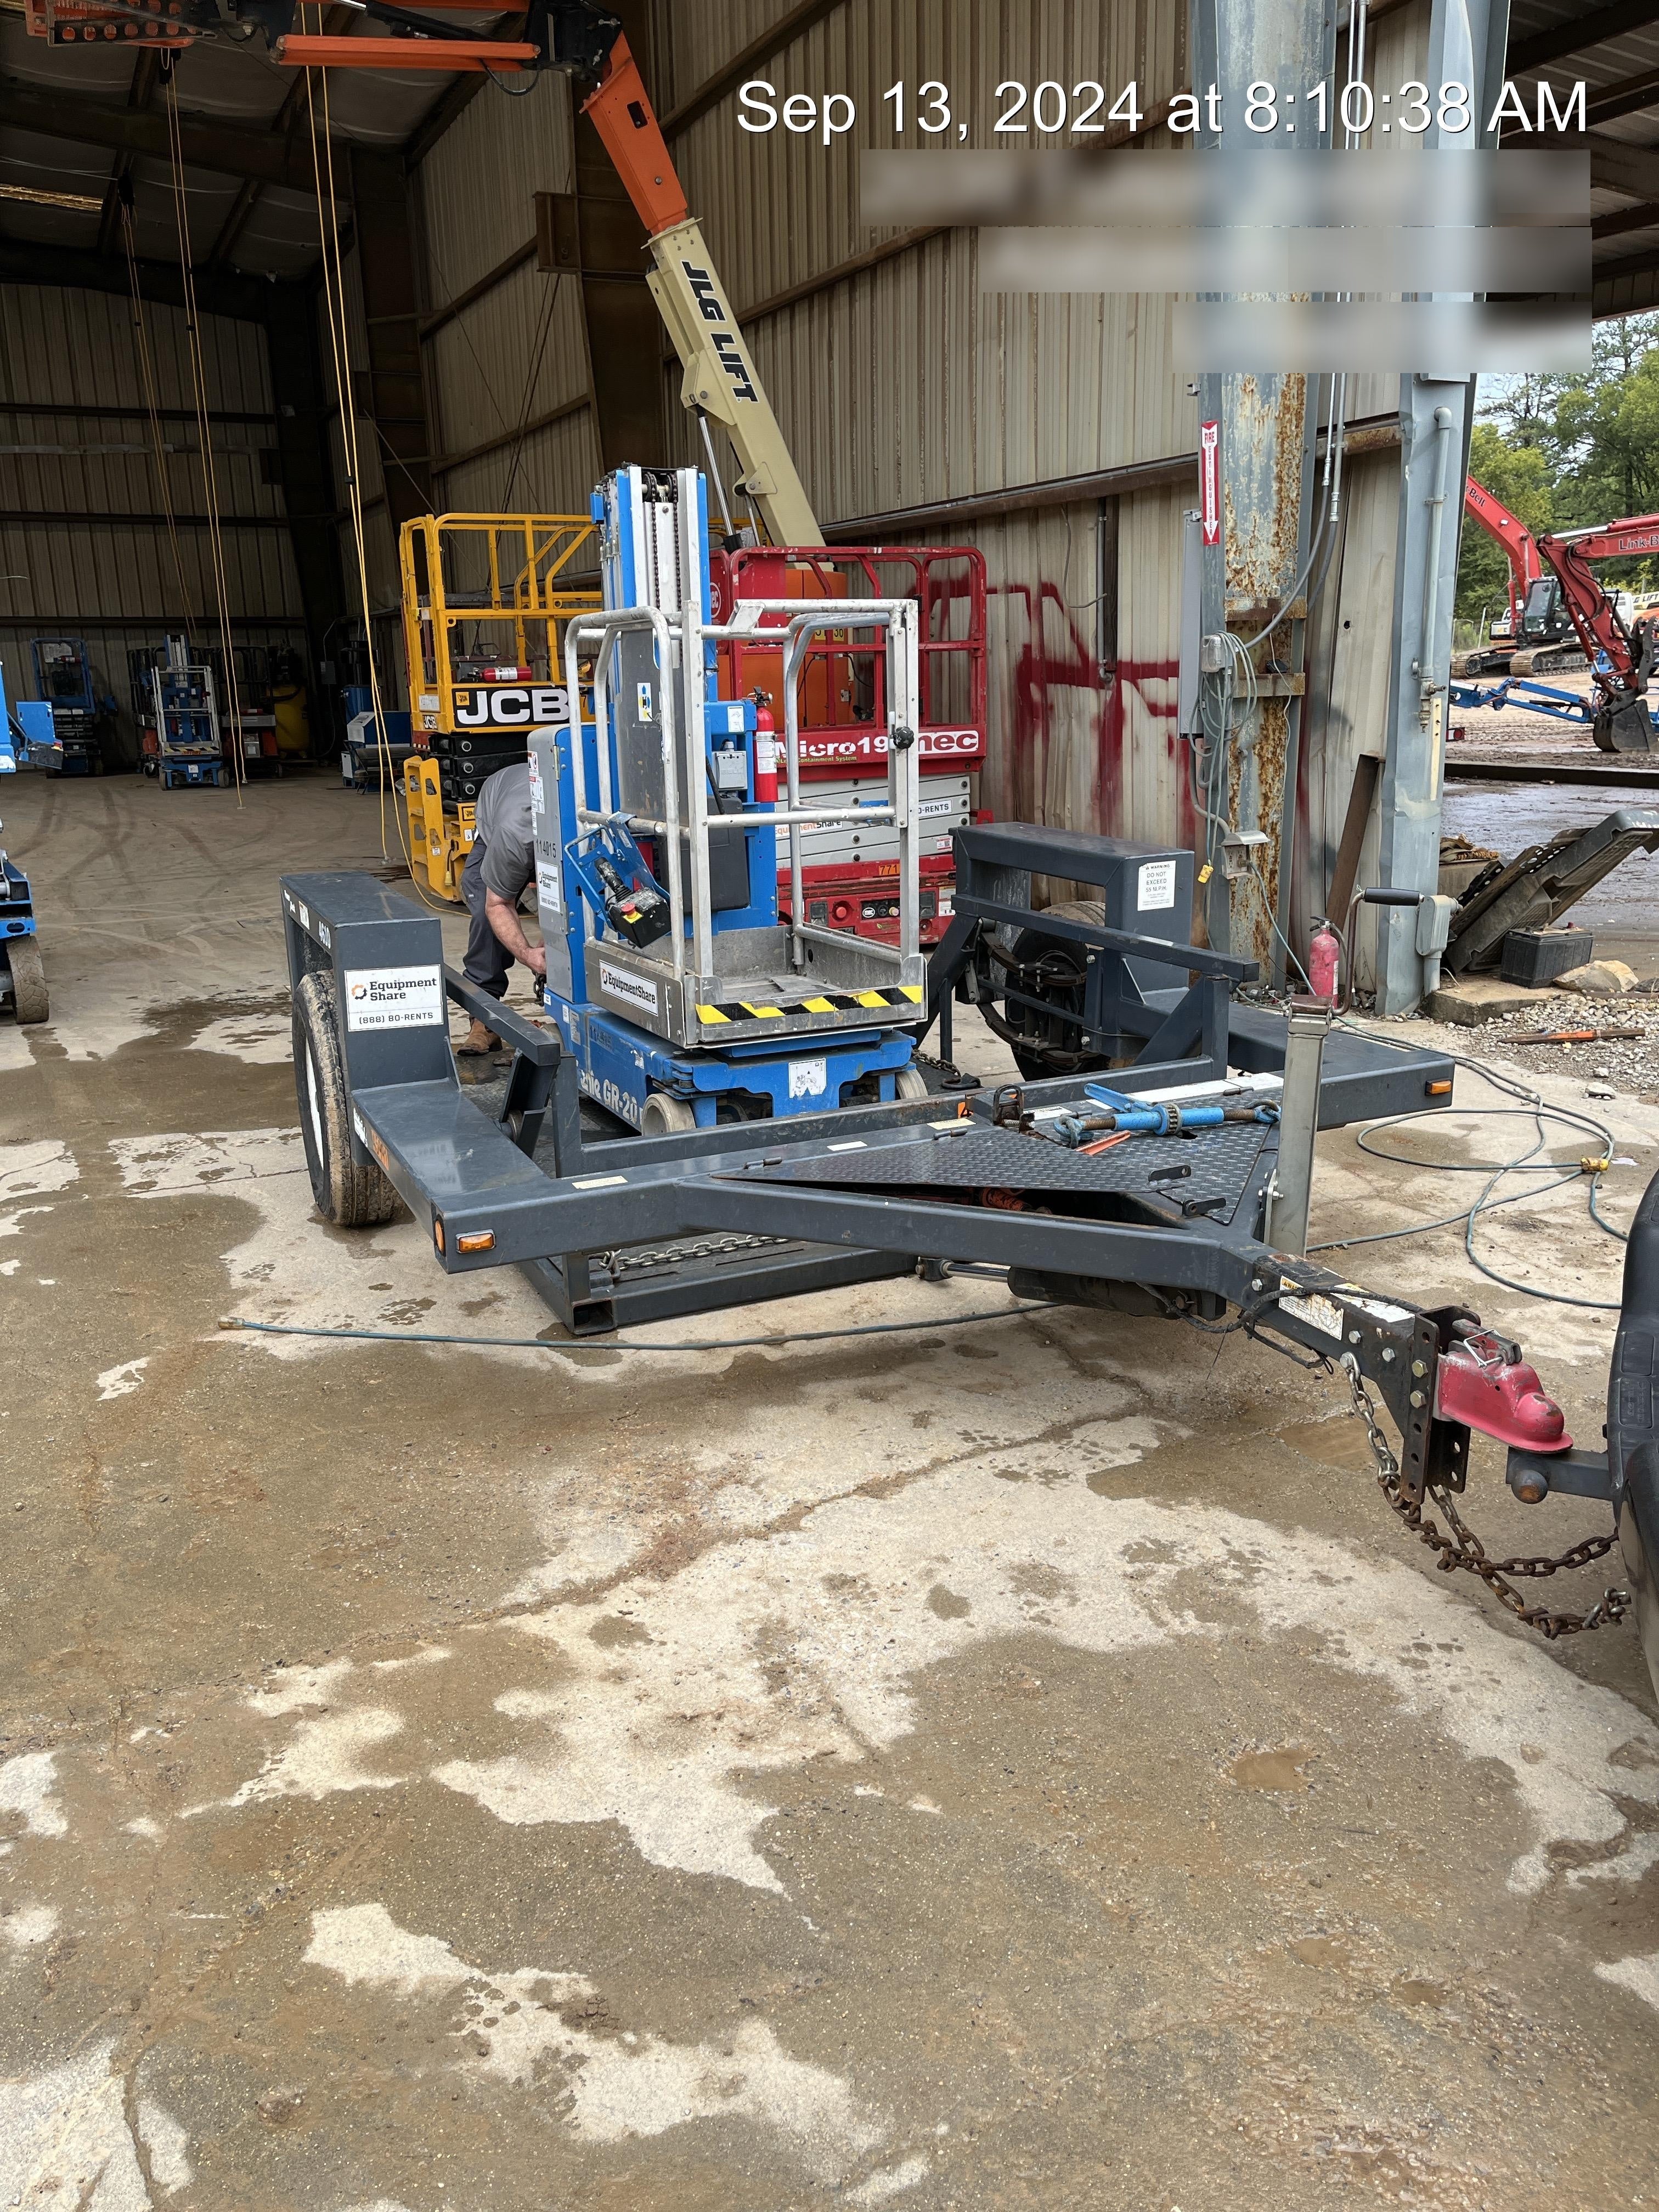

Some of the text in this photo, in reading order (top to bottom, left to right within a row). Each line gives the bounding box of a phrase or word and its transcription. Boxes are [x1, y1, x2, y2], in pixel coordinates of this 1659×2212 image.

[682, 261, 759, 403] JLG LIFT
[1204, 431, 1215, 444] FIRE
[456, 689, 571, 724] JCB
[424, 715, 438, 730] JCB
[535, 838, 556, 859] 114015
[319, 921, 331, 949] 4610
[369, 978, 437, 991] Equipment
[608, 972, 656, 1004] EquipmentShare
[370, 992, 407, 1001] Share
[359, 1012, 433, 1025] (888) 80-RENTS
[603, 1079, 638, 1125] GR-20
